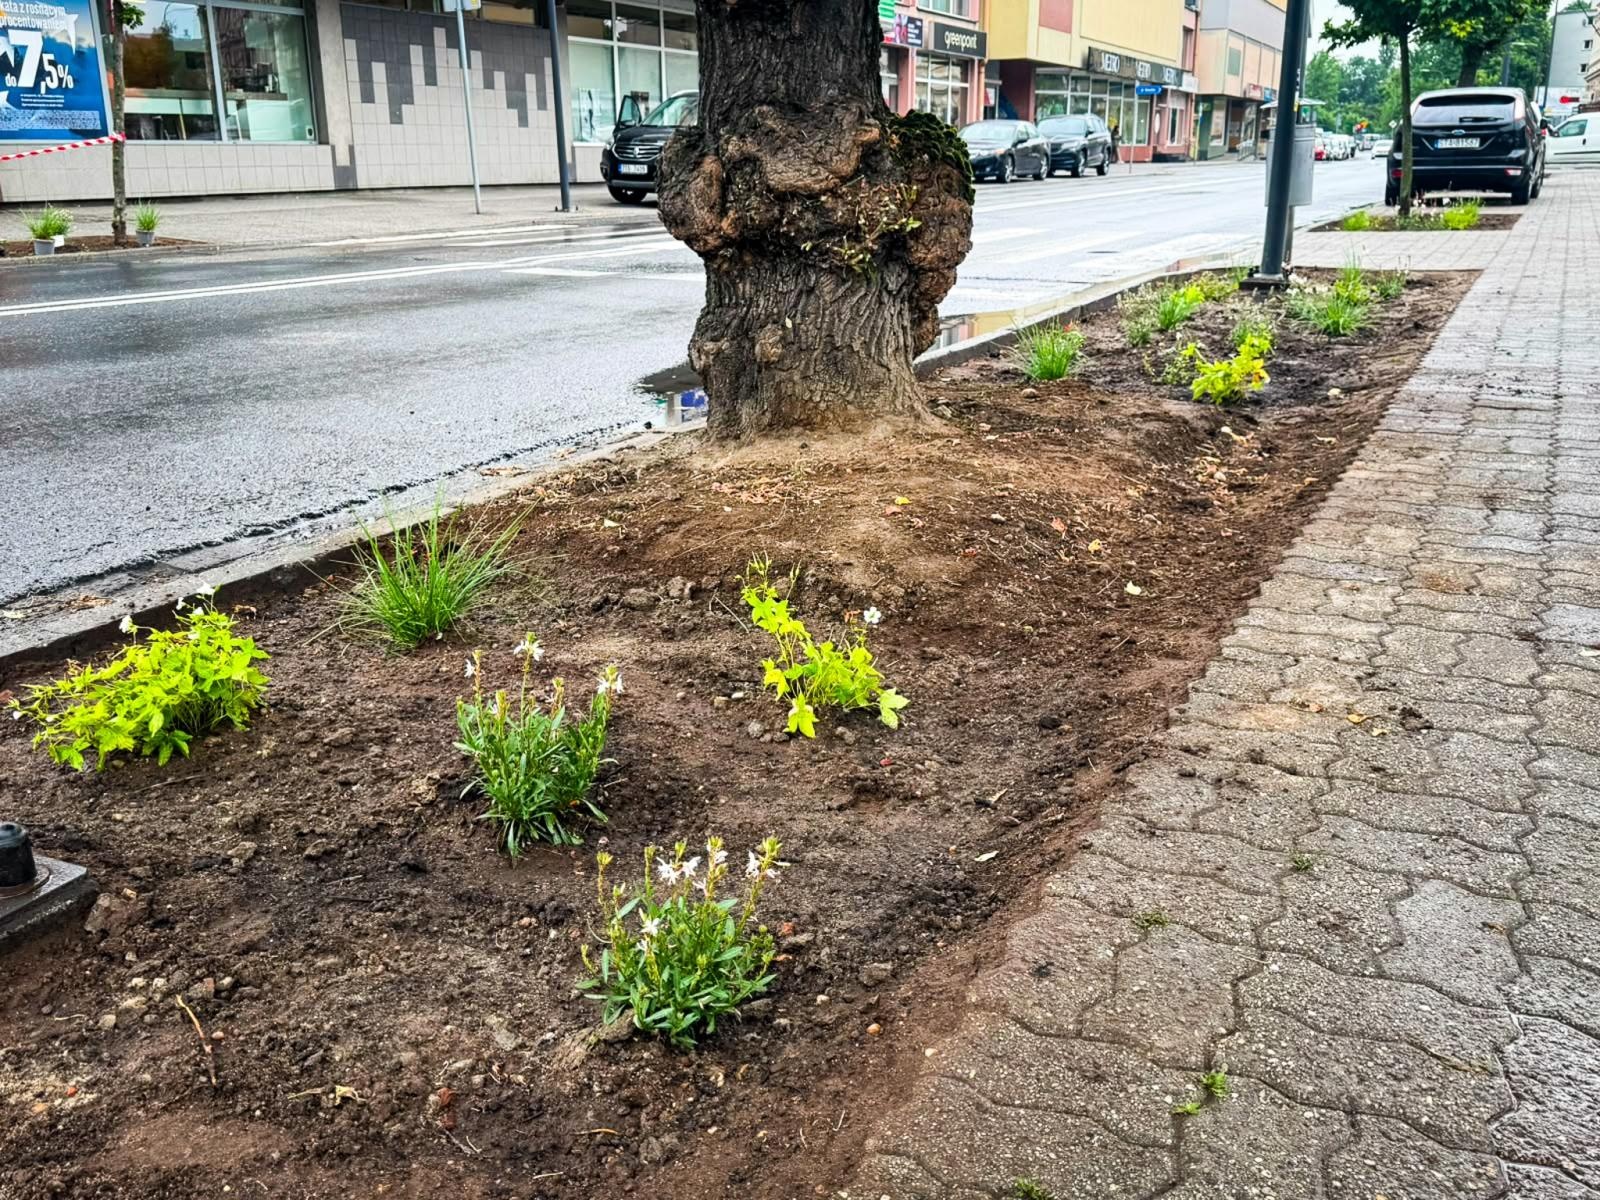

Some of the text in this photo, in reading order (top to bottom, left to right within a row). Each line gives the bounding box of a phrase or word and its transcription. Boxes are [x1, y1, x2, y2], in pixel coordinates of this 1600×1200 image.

[19, 4, 25, 13] z
[26, 4, 65, 17] rosnącym
[944, 31, 977, 52] greenpoint
[5, 73, 17, 87] do
